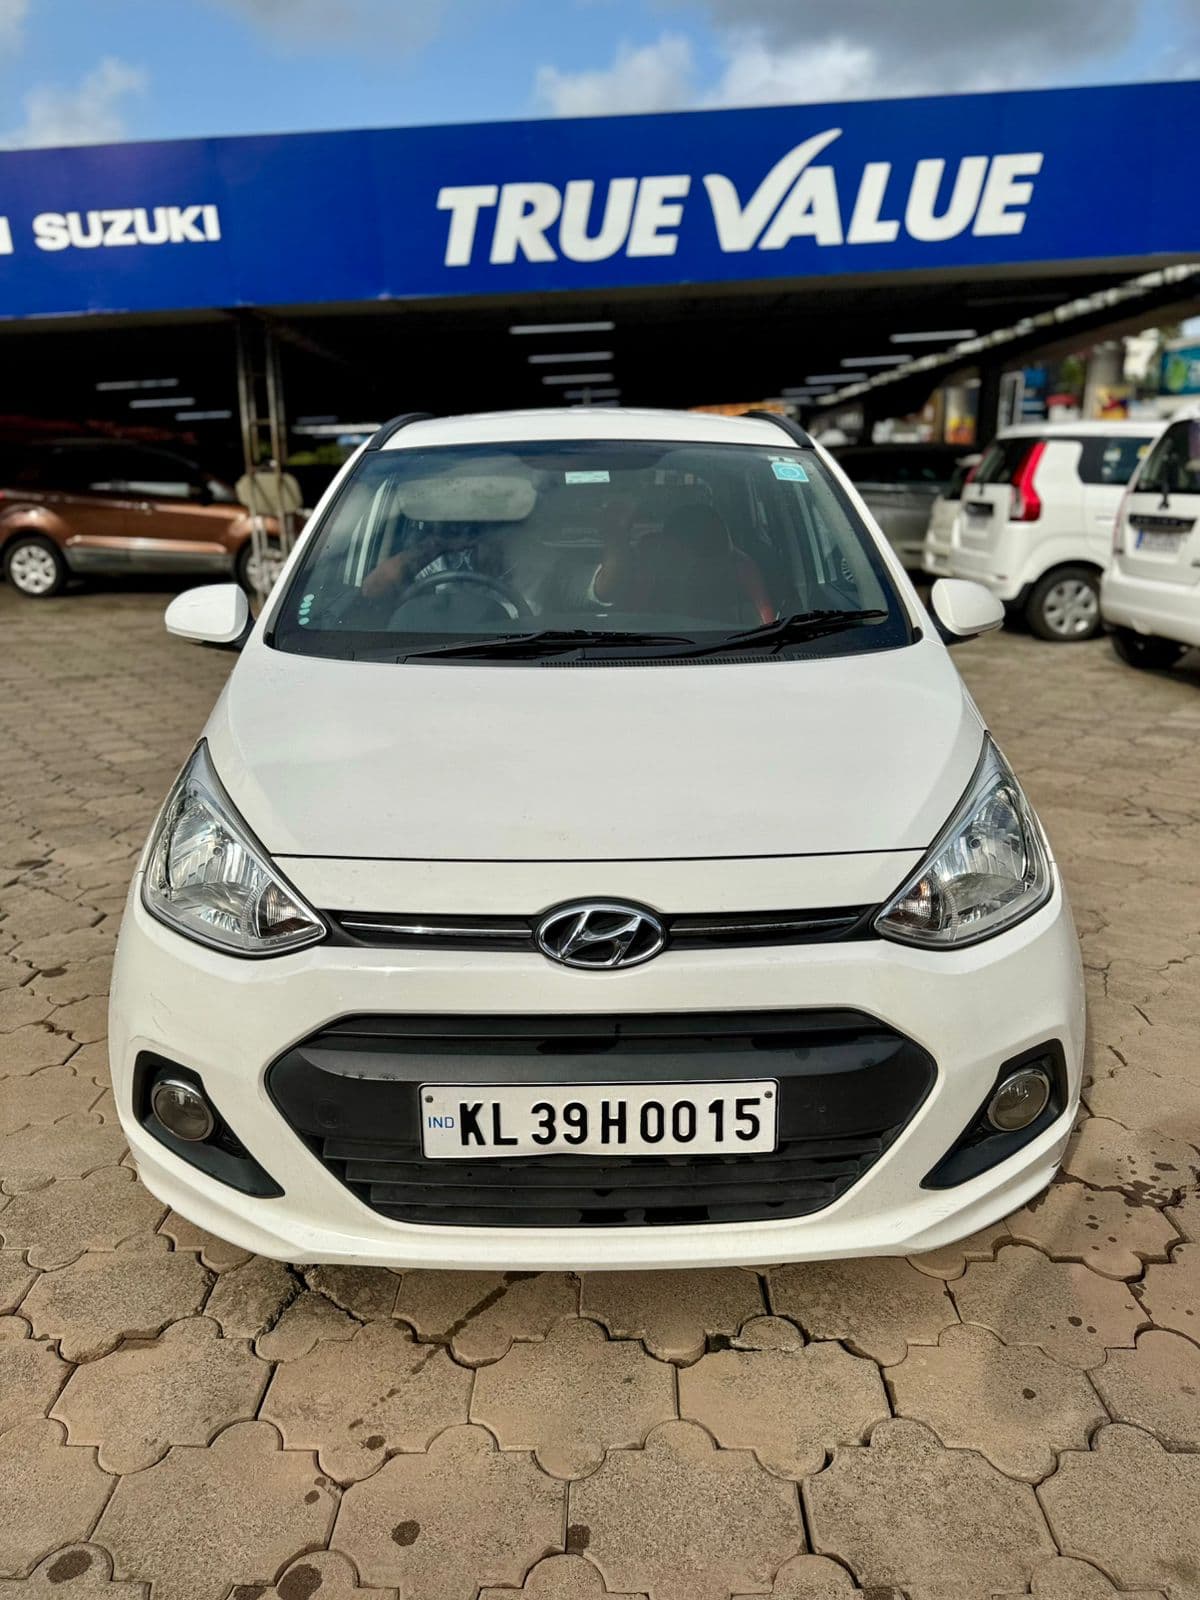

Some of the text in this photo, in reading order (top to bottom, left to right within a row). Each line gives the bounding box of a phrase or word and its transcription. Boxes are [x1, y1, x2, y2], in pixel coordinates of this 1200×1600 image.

[436, 127, 1044, 268] TRUE VALUE
[32, 204, 221, 252] SUZUKI
[427, 1115, 455, 1130] IND
[459, 1102, 519, 1146] KL
[530, 1102, 588, 1145] 39
[639, 1097, 761, 1144] 0015
